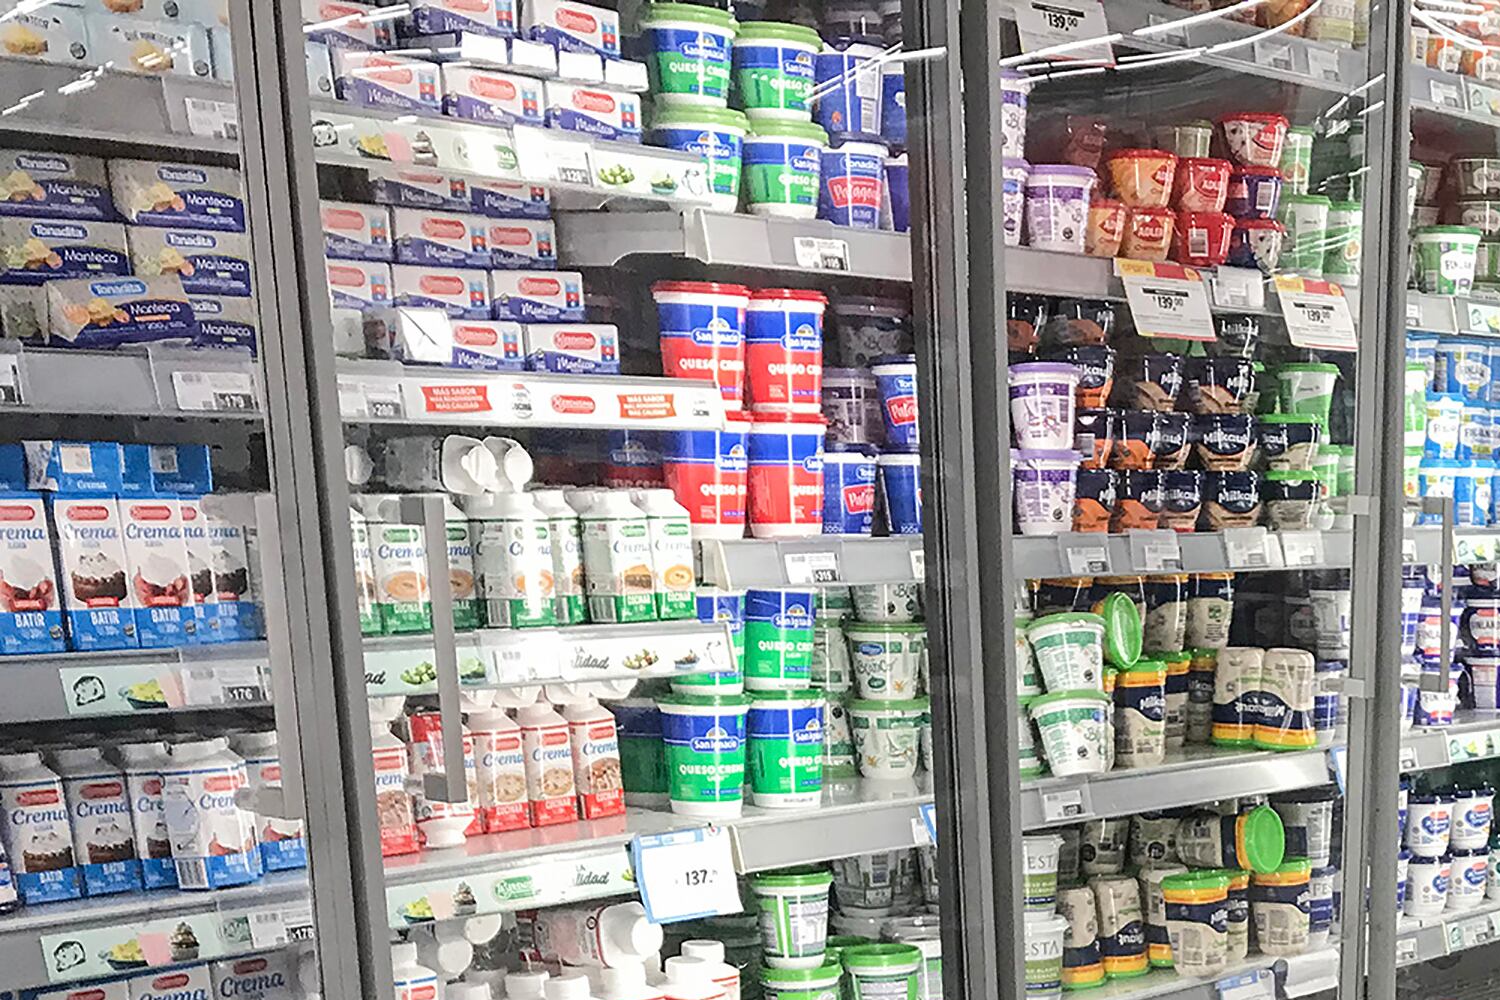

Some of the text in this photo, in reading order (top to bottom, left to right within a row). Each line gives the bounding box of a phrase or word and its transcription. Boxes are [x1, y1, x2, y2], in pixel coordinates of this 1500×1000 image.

[48, 184, 100, 198] Manteca
[186, 193, 234, 208] Manteca
[64, 250, 118, 265] Manteca
[196, 258, 244, 273] Manteca
[130, 302, 180, 316] Manteca
[201, 322, 251, 337] Manteca
[0, 526, 46, 542] rema
[126, 525, 182, 541] Crema
[15, 614, 45, 628] BATIR
[91, 612, 120, 627] BATIR
[152, 610, 180, 624] BATIR
[76, 801, 130, 818] Crema
[200, 795, 236, 809] Crem
[12, 807, 69, 826] Crema
[220, 972, 286, 998] Crema
